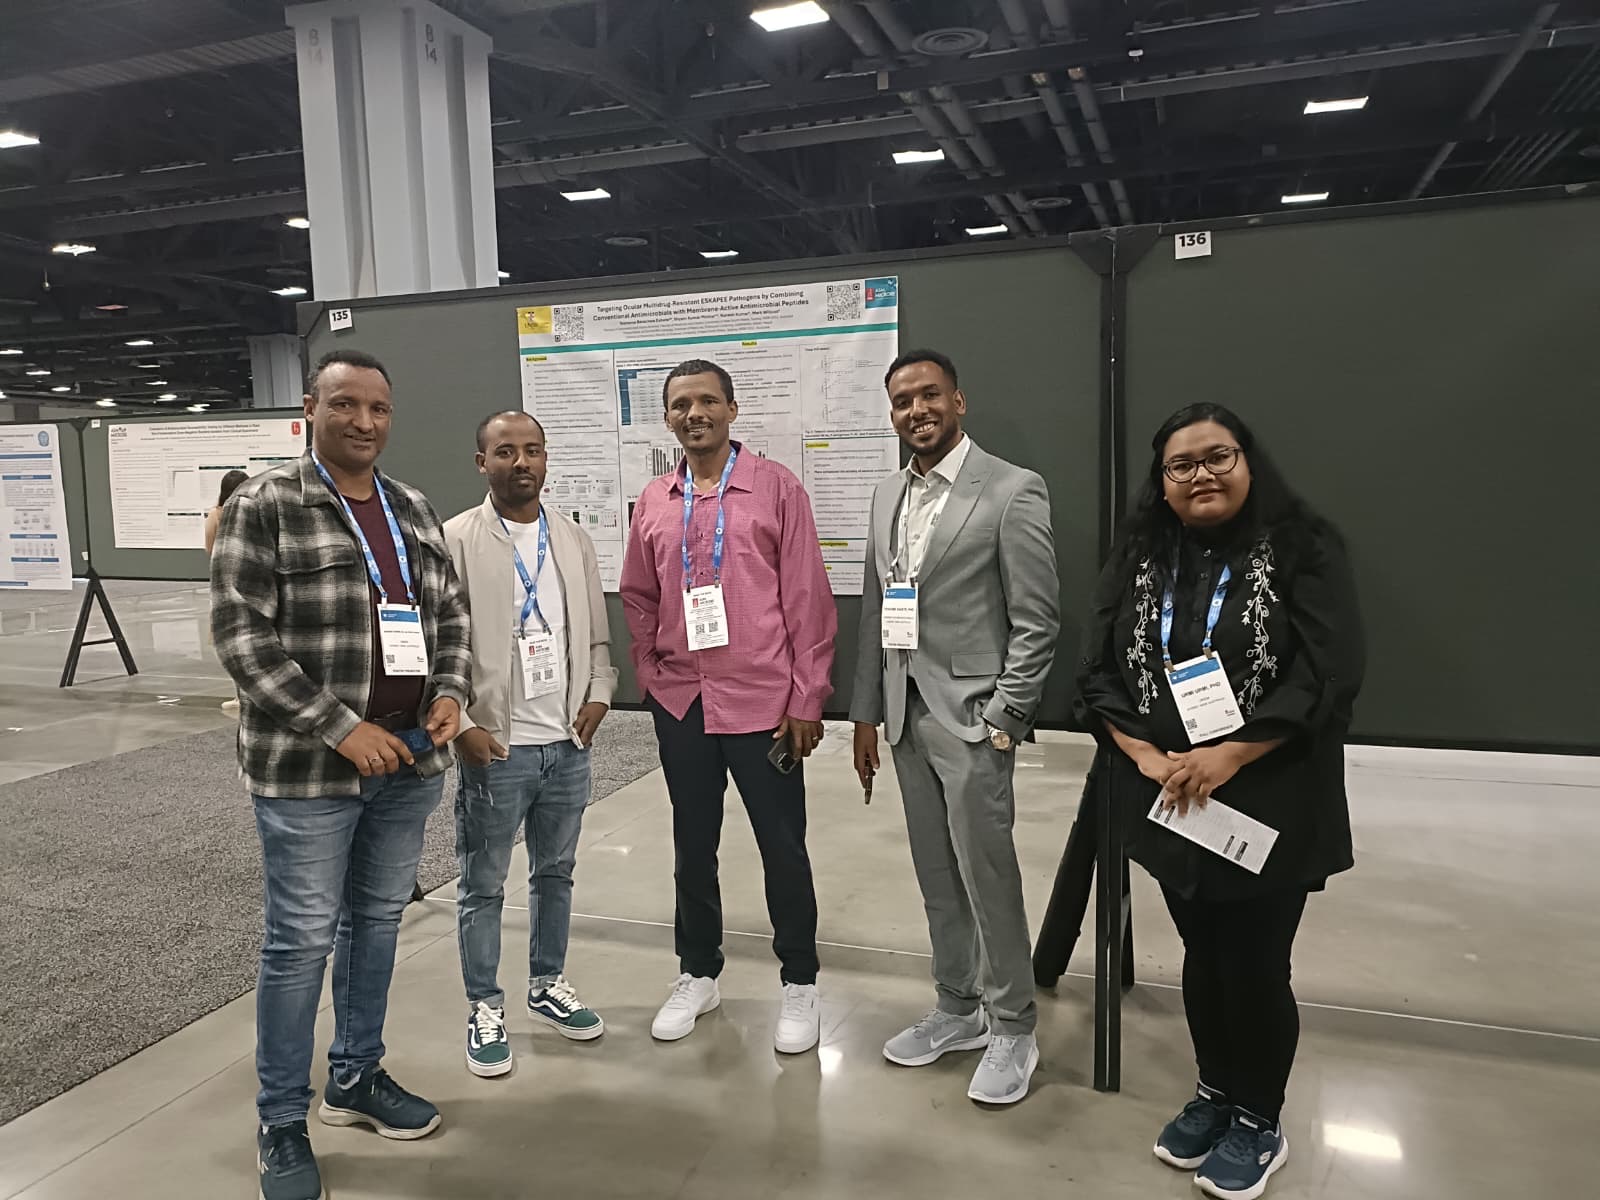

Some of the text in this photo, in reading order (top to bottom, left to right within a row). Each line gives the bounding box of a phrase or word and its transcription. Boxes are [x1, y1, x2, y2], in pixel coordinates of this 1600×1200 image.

[425, 44, 438, 64] 14
[1179, 232, 1206, 247] 136
[593, 313, 630, 321] Conventional
[630, 310, 672, 318] Antimicrobials
[673, 307, 686, 315] with
[687, 303, 739, 313] Membrane-Active
[740, 301, 781, 309] Antimicrobial
[781, 299, 809, 307] Peptides
[597, 304, 622, 313] Targeting
[769, 290, 804, 298] Combining
[332, 310, 348, 322] 135
